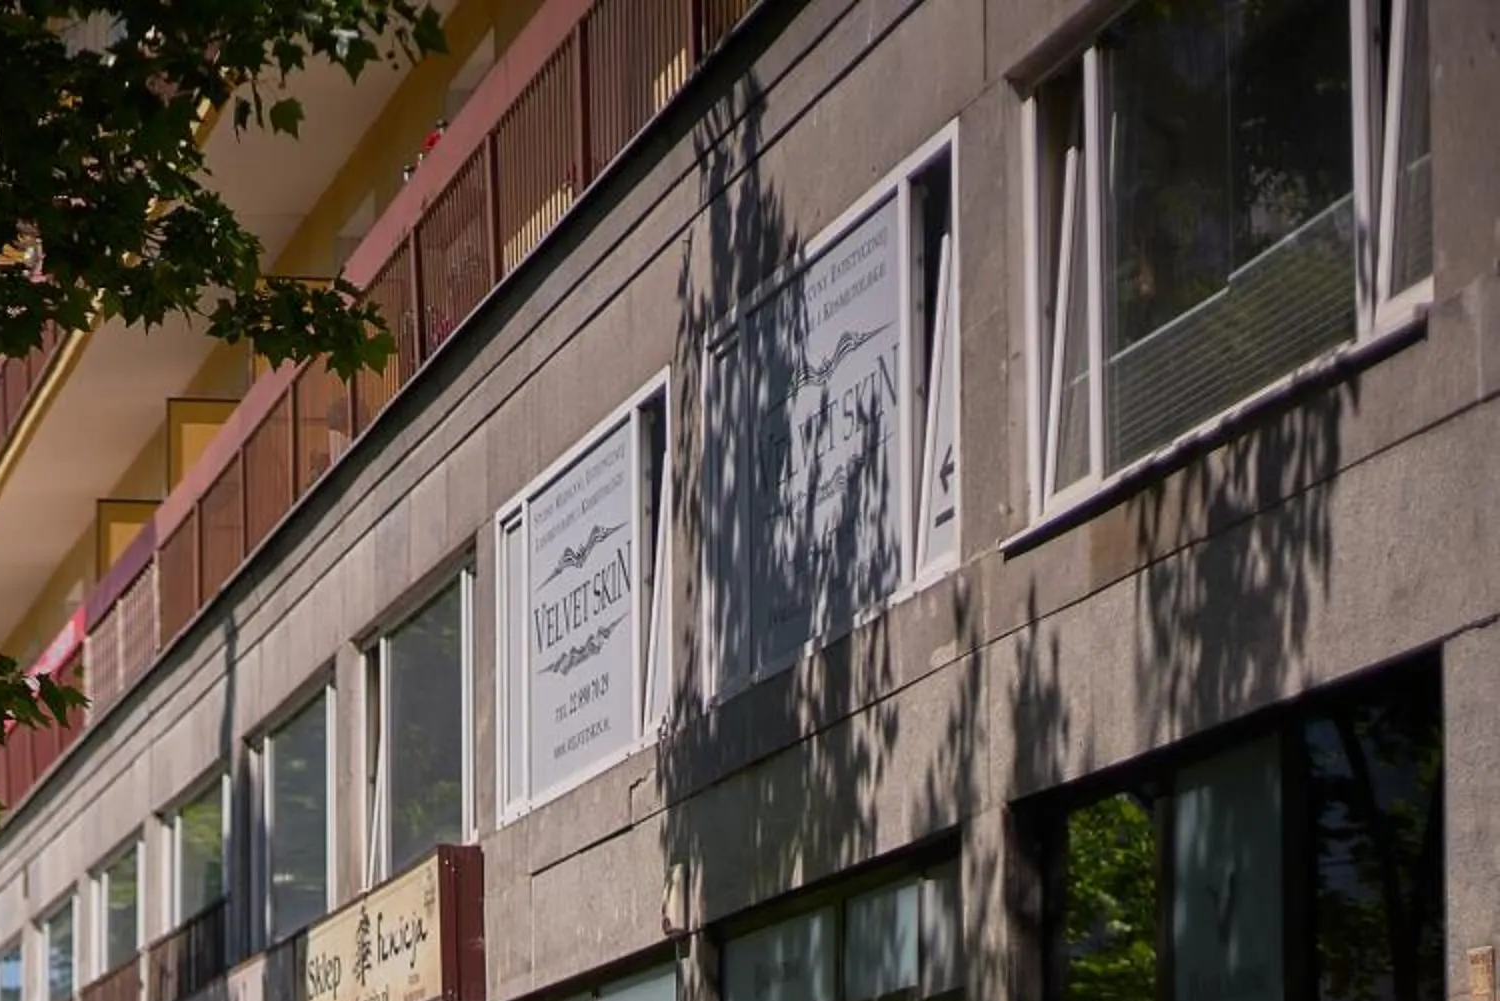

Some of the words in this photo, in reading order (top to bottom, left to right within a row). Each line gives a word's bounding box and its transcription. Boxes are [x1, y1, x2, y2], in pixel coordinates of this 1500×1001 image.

[843, 342, 900, 441] SKIN
[533, 579, 591, 654] VELVET
[593, 540, 632, 617] SKIN
[308, 953, 341, 1001] Sklep
